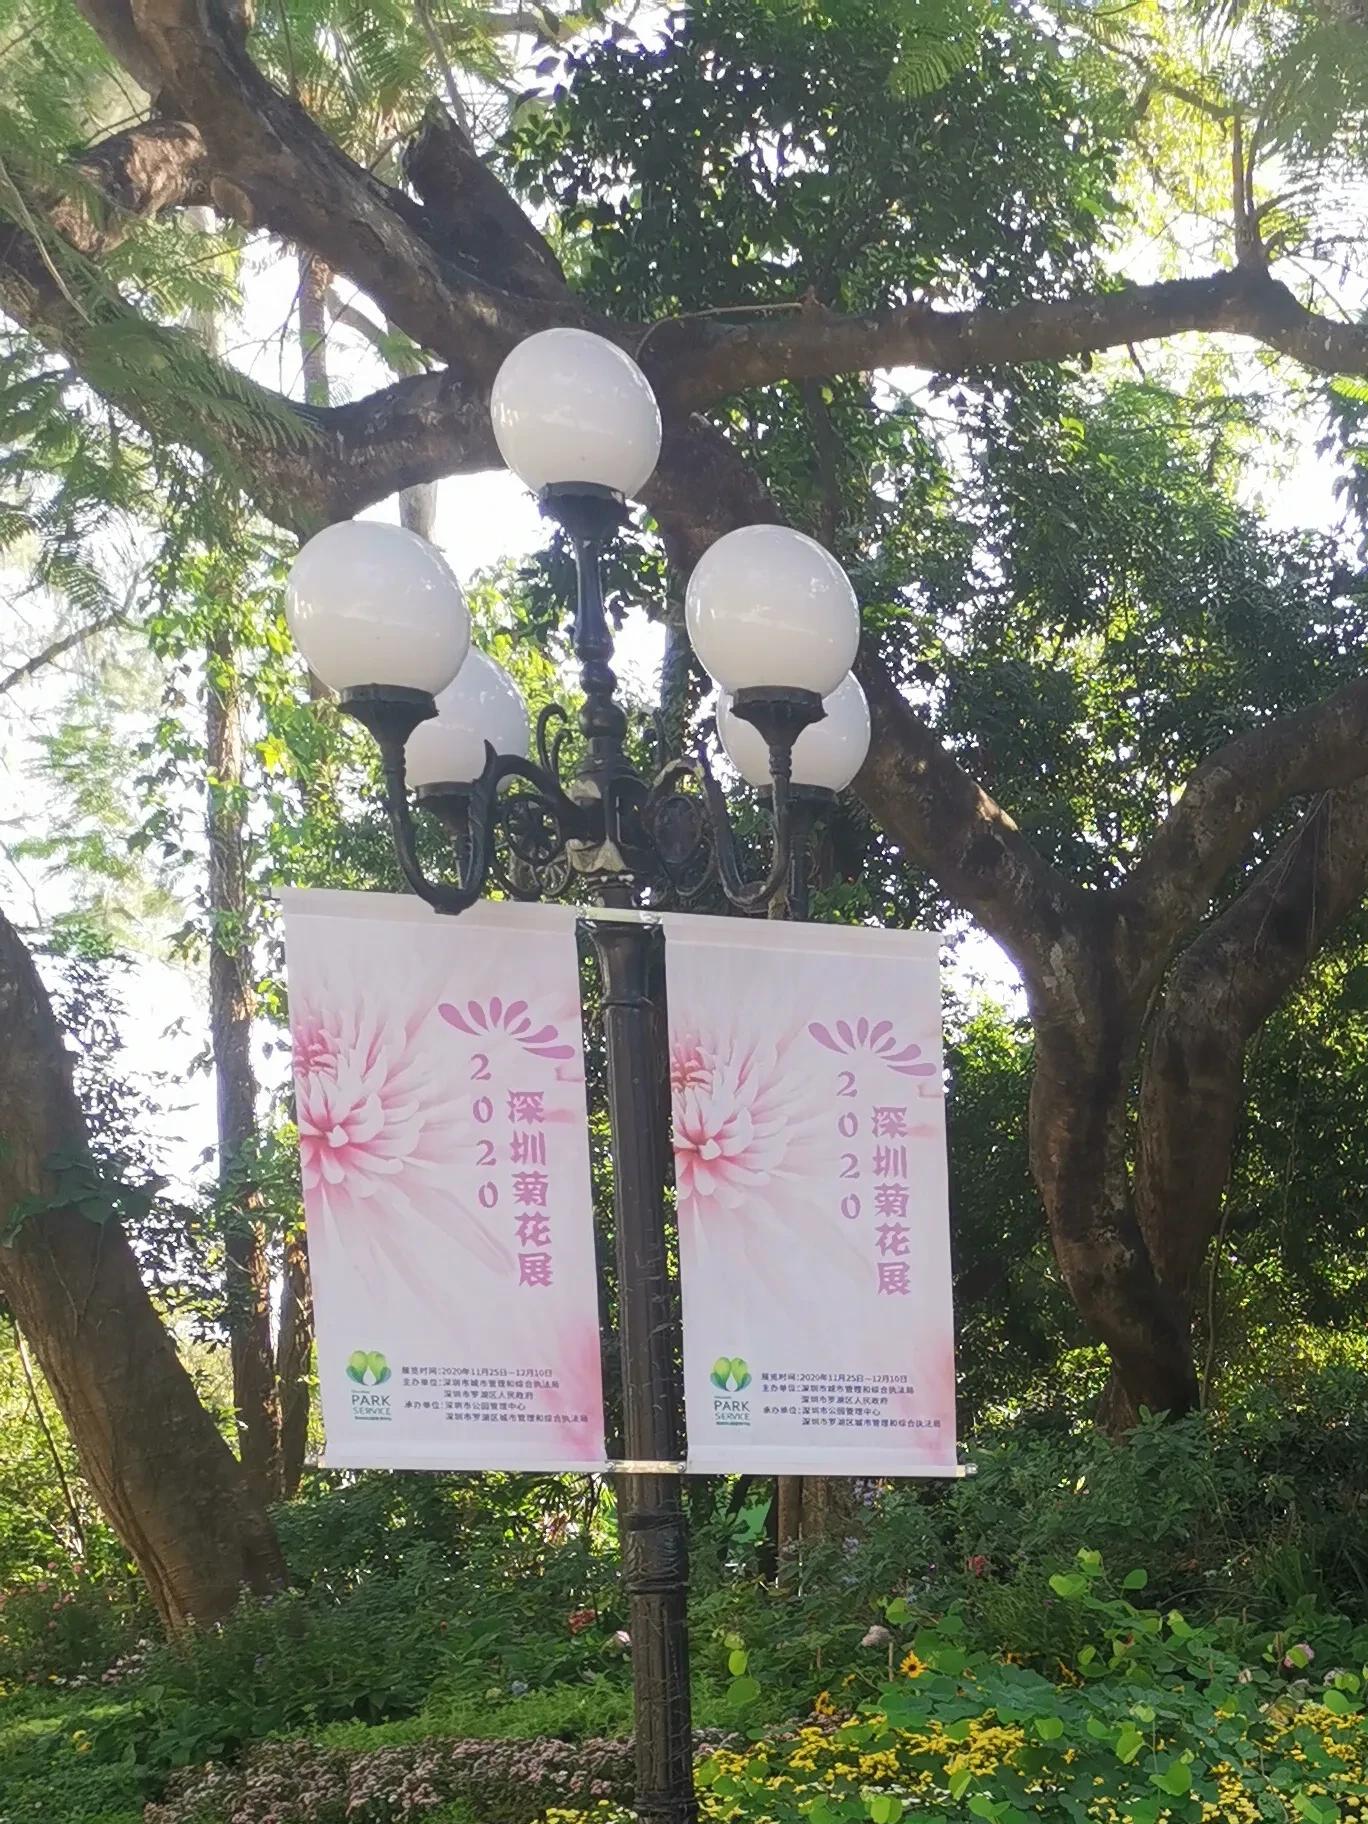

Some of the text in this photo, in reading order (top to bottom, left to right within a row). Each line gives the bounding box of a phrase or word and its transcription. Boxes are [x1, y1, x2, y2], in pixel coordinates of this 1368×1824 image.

[470, 1054, 499, 1209] 2020
[837, 1072, 862, 1220] 2020
[508, 1089, 554, 1288] 深圳菊花展
[871, 1106, 911, 1296] 深圳菊花展
[352, 1395, 391, 1406] PARK
[352, 1407, 391, 1415] SERVICE
[714, 1400, 750, 1412] PARK
[715, 1412, 750, 1421] SERVICE
